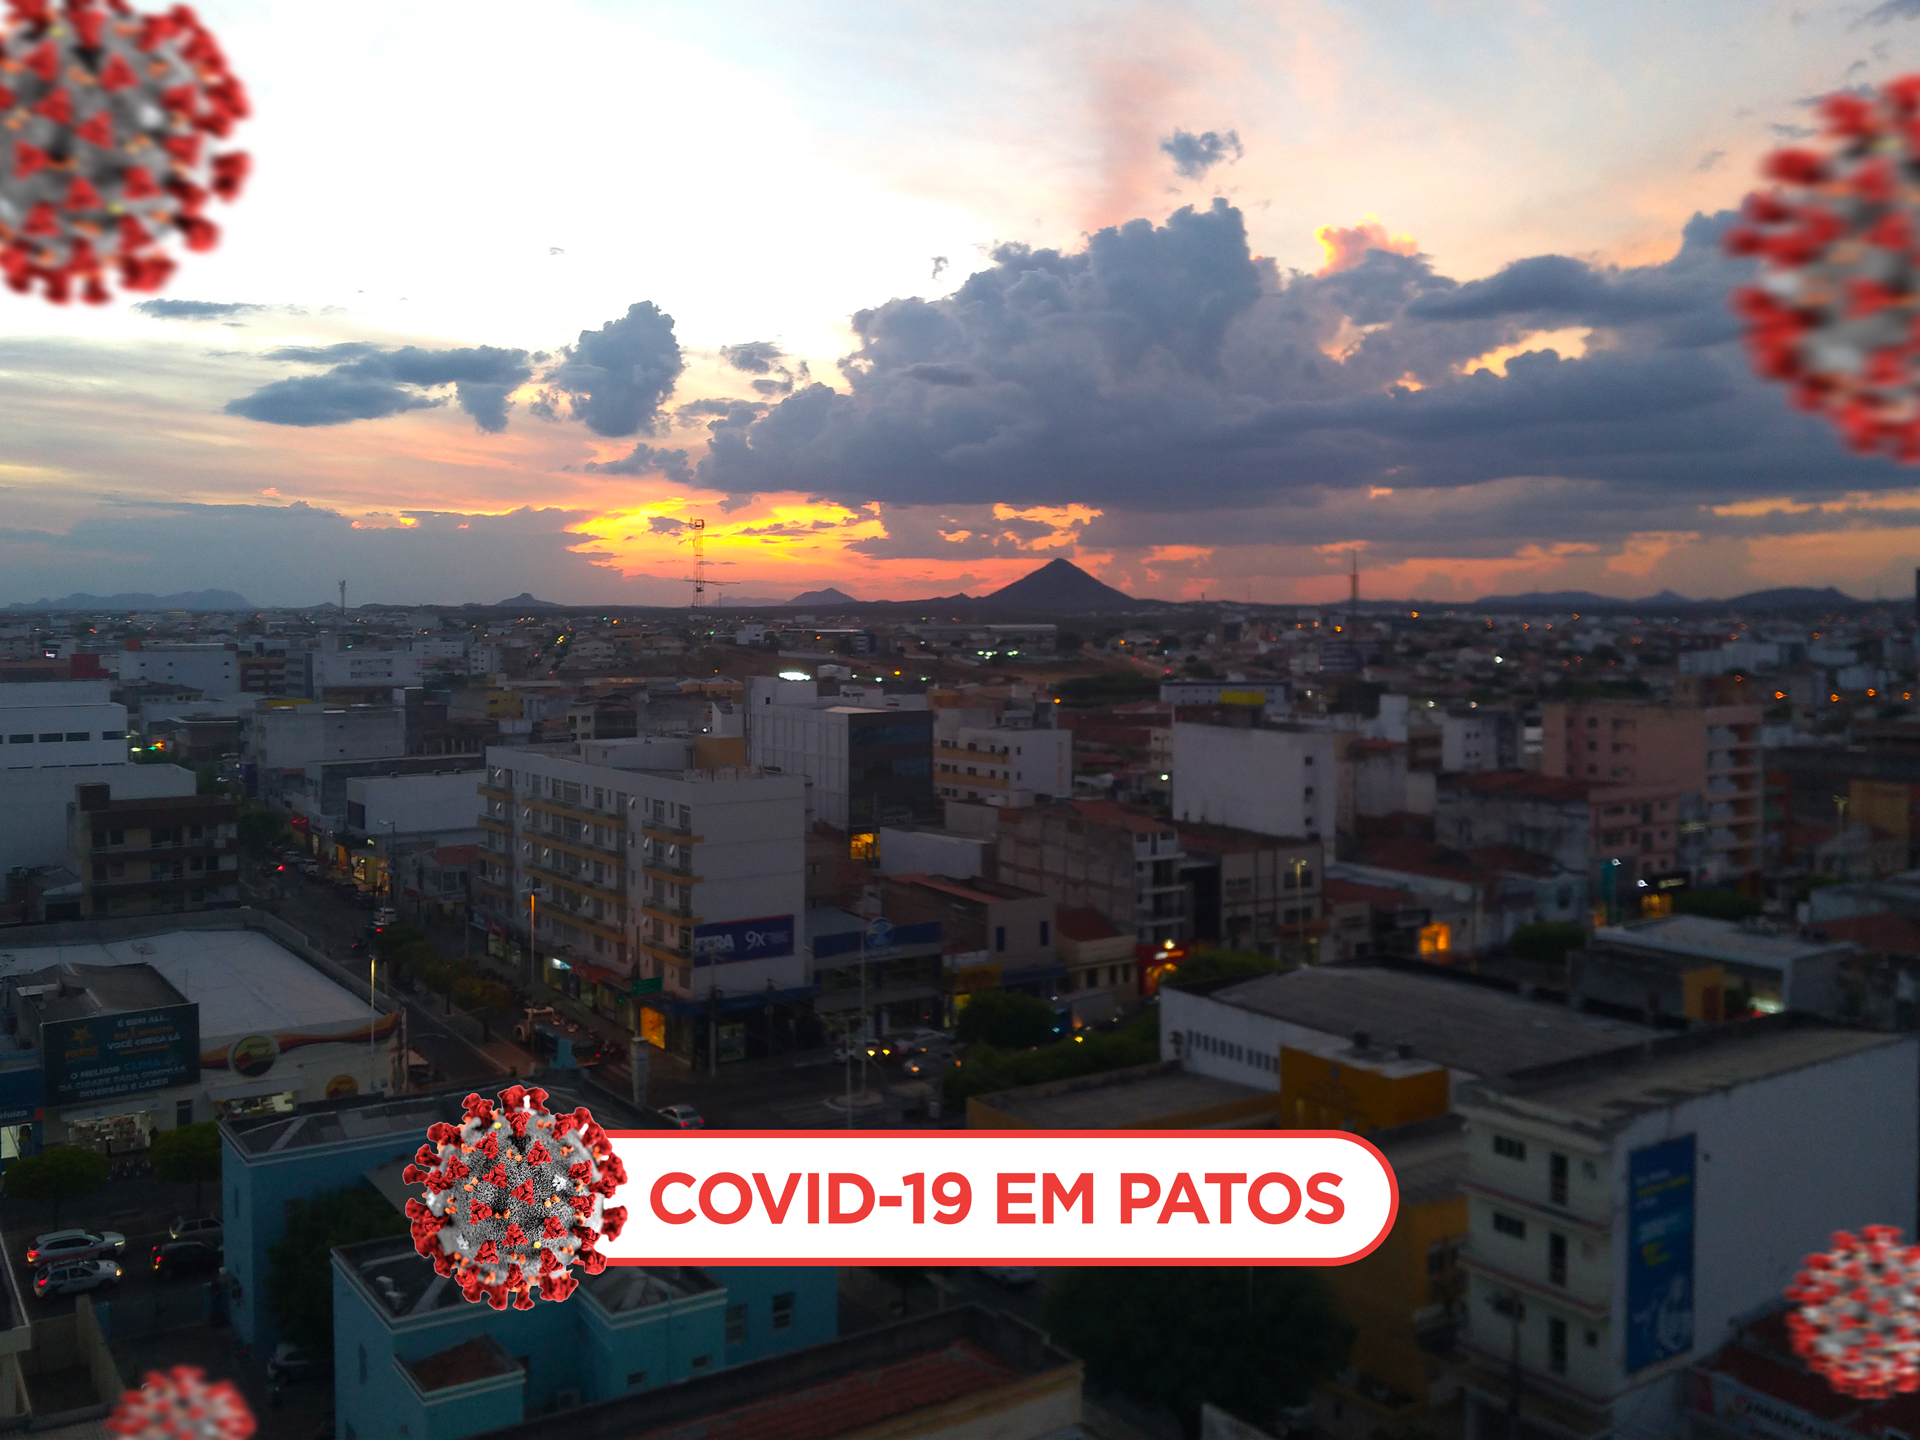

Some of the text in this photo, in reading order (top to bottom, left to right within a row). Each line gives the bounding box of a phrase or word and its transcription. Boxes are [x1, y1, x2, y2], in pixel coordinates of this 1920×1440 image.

[107, 1039, 133, 1050] VOCÊ
[80, 1066, 120, 1078] MELHOR
[123, 1058, 160, 1071] CLIMA
[75, 1077, 112, 1090] CIDADE
[113, 1072, 139, 1084] PARA
[79, 1083, 128, 1099] DIVERSÃO
[139, 1077, 169, 1089] LAZER
